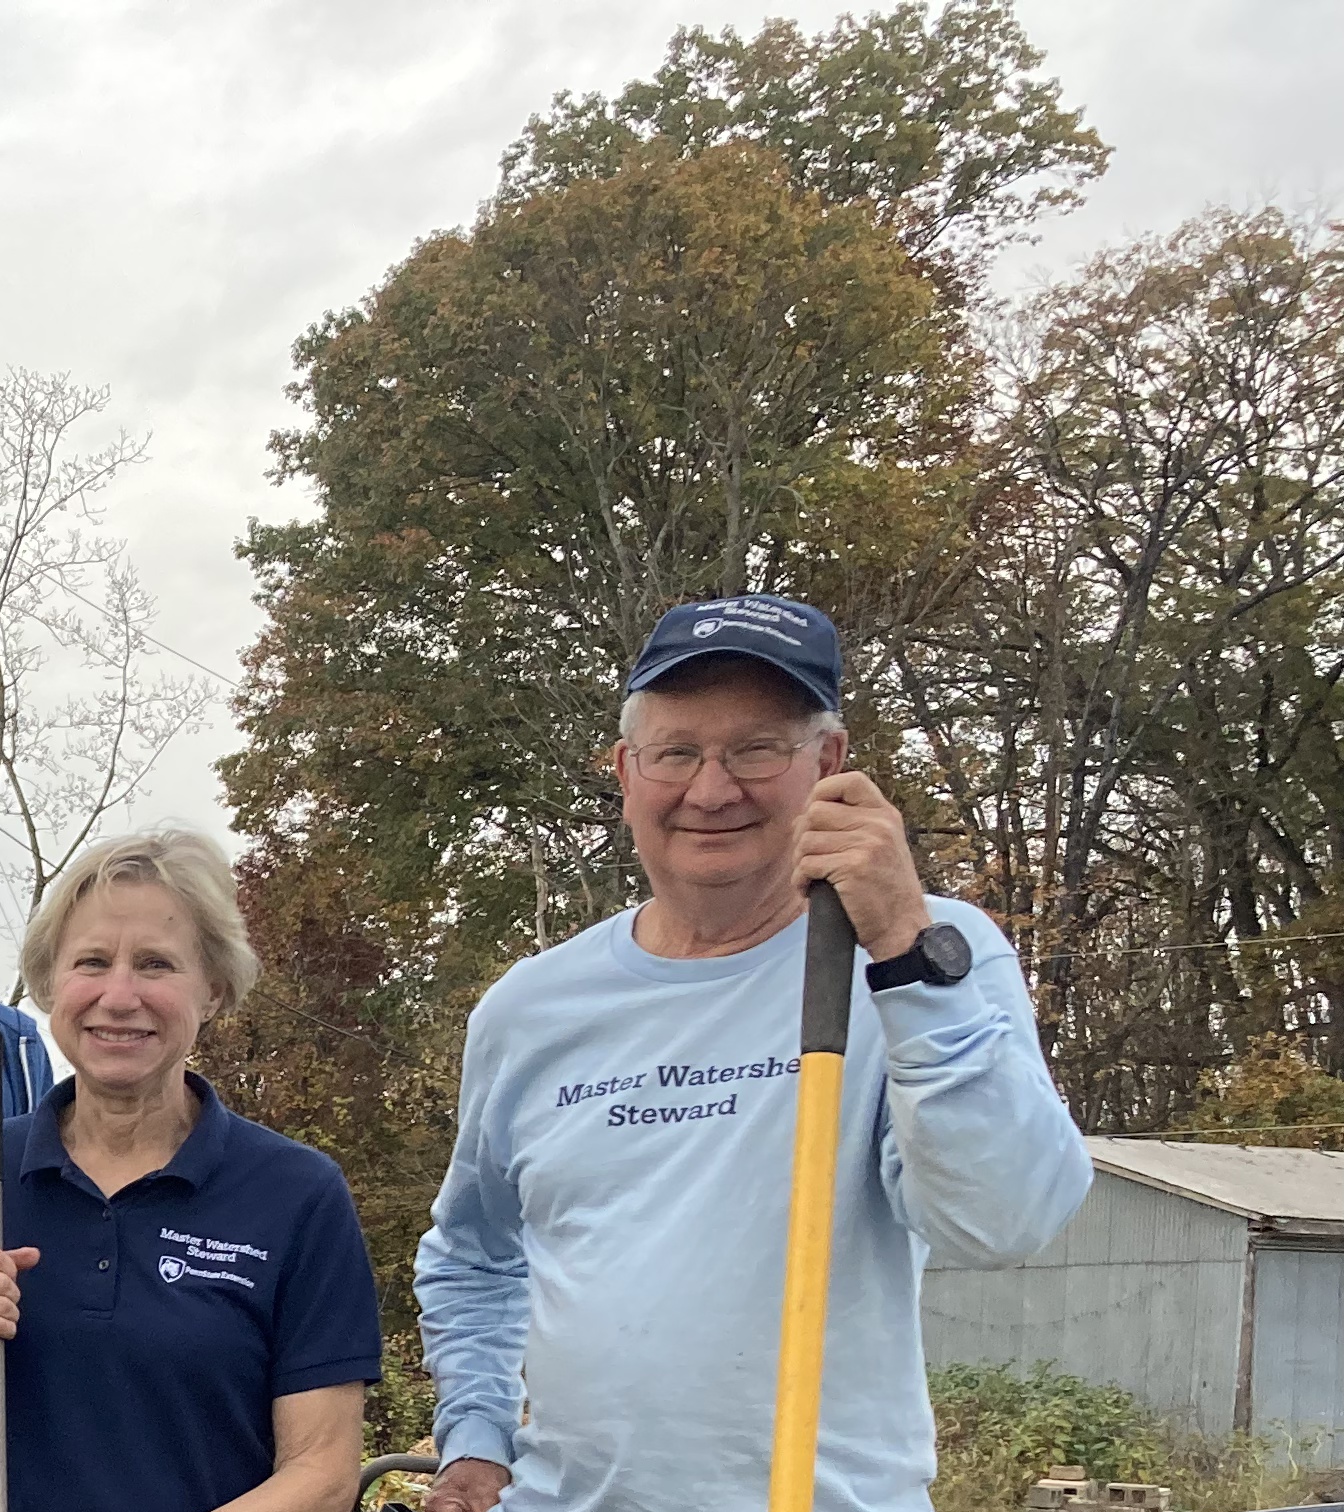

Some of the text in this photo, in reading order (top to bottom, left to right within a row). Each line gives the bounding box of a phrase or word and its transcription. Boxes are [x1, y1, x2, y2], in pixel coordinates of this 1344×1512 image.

[556, 1056, 802, 1107] Master Watershe
[606, 1094, 738, 1128] Steward
[159, 1227, 269, 1261] Master Watershed
[186, 1245, 237, 1263] Steward
